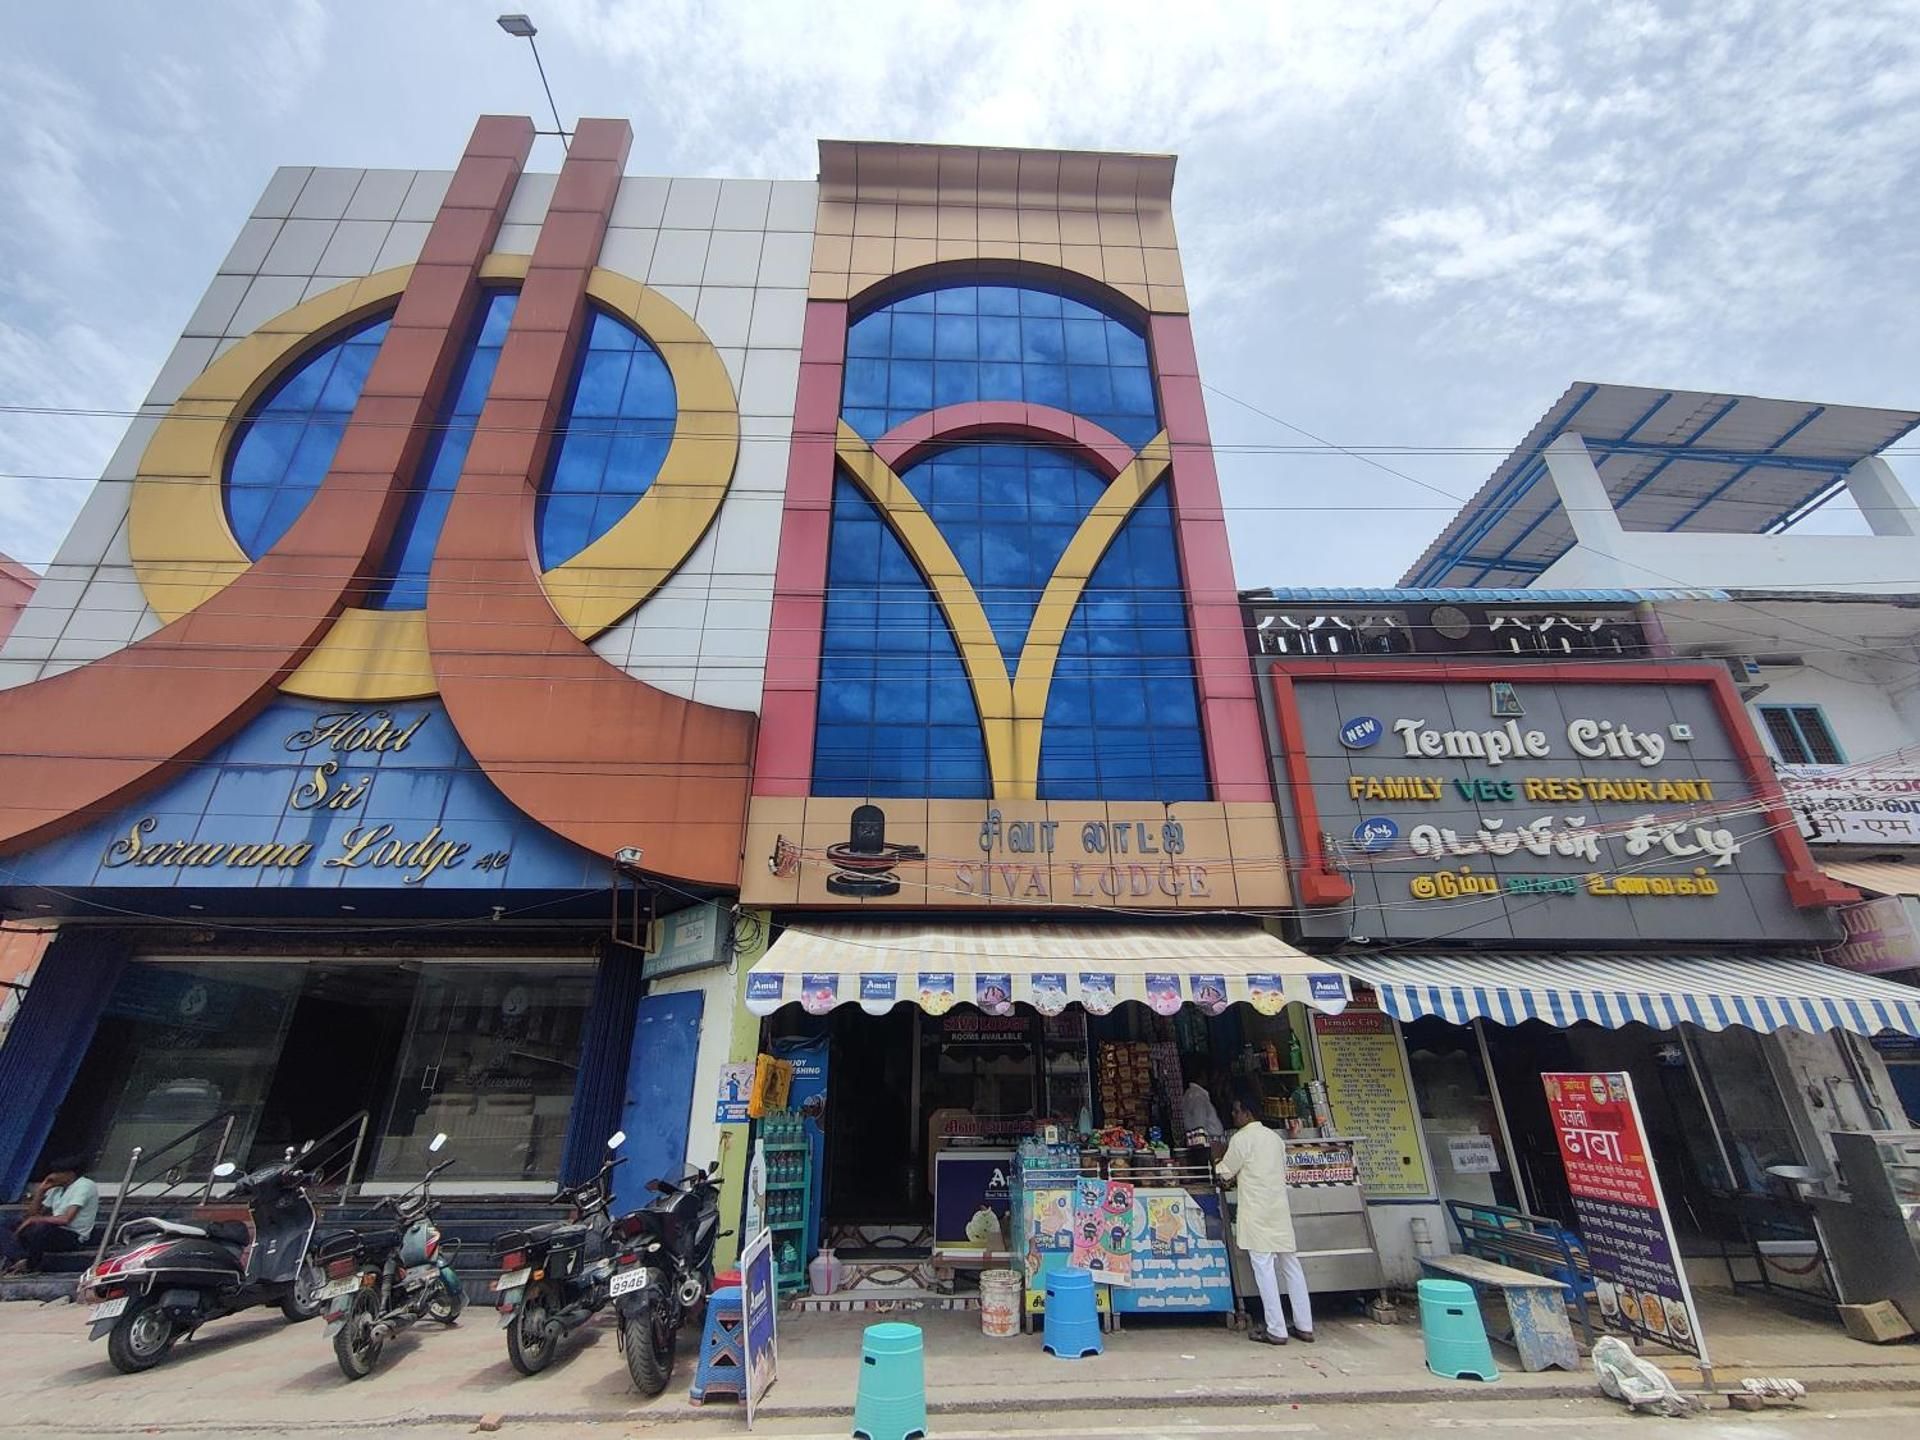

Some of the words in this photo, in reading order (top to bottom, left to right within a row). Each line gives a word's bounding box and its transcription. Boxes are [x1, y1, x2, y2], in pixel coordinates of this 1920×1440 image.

[284, 710, 430, 753] Hotel
[1346, 719, 1376, 743] NEW
[1393, 718, 1550, 766] Temple
[1567, 718, 1665, 767] City
[290, 761, 371, 811] Sri
[1348, 776, 1444, 800] FAMILY
[1454, 777, 1516, 801] VEG
[1524, 777, 1714, 802] RESTAURANT
[979, 809, 1059, 853] சிவா
[1081, 815, 1185, 854] லாட்ஜ்
[102, 816, 313, 869] Saravana
[322, 823, 472, 884] Lodge
[956, 864, 1048, 897] SIVA
[1072, 863, 1212, 898] LODGE
[1411, 865, 1499, 899] குடும்ப
[1585, 867, 1719, 895] உணவகம்
[753, 981, 778, 990] Amul
[866, 980, 891, 989] Amul
[1316, 981, 1340, 990] Amul
[1324, 1018, 1356, 1028] Temple
[1358, 1018, 1379, 1029] City
[951, 1033, 979, 1041] ROOMS
[981, 1032, 1022, 1041] AVAILABLE
[1559, 1103, 1587, 1127] पंजाबी
[1560, 1127, 1623, 1164] ढाबा
[1297, 1170, 1323, 1182] FILTER
[1323, 1168, 1353, 1180] COFFEE
[611, 1275, 645, 1295] 9946
